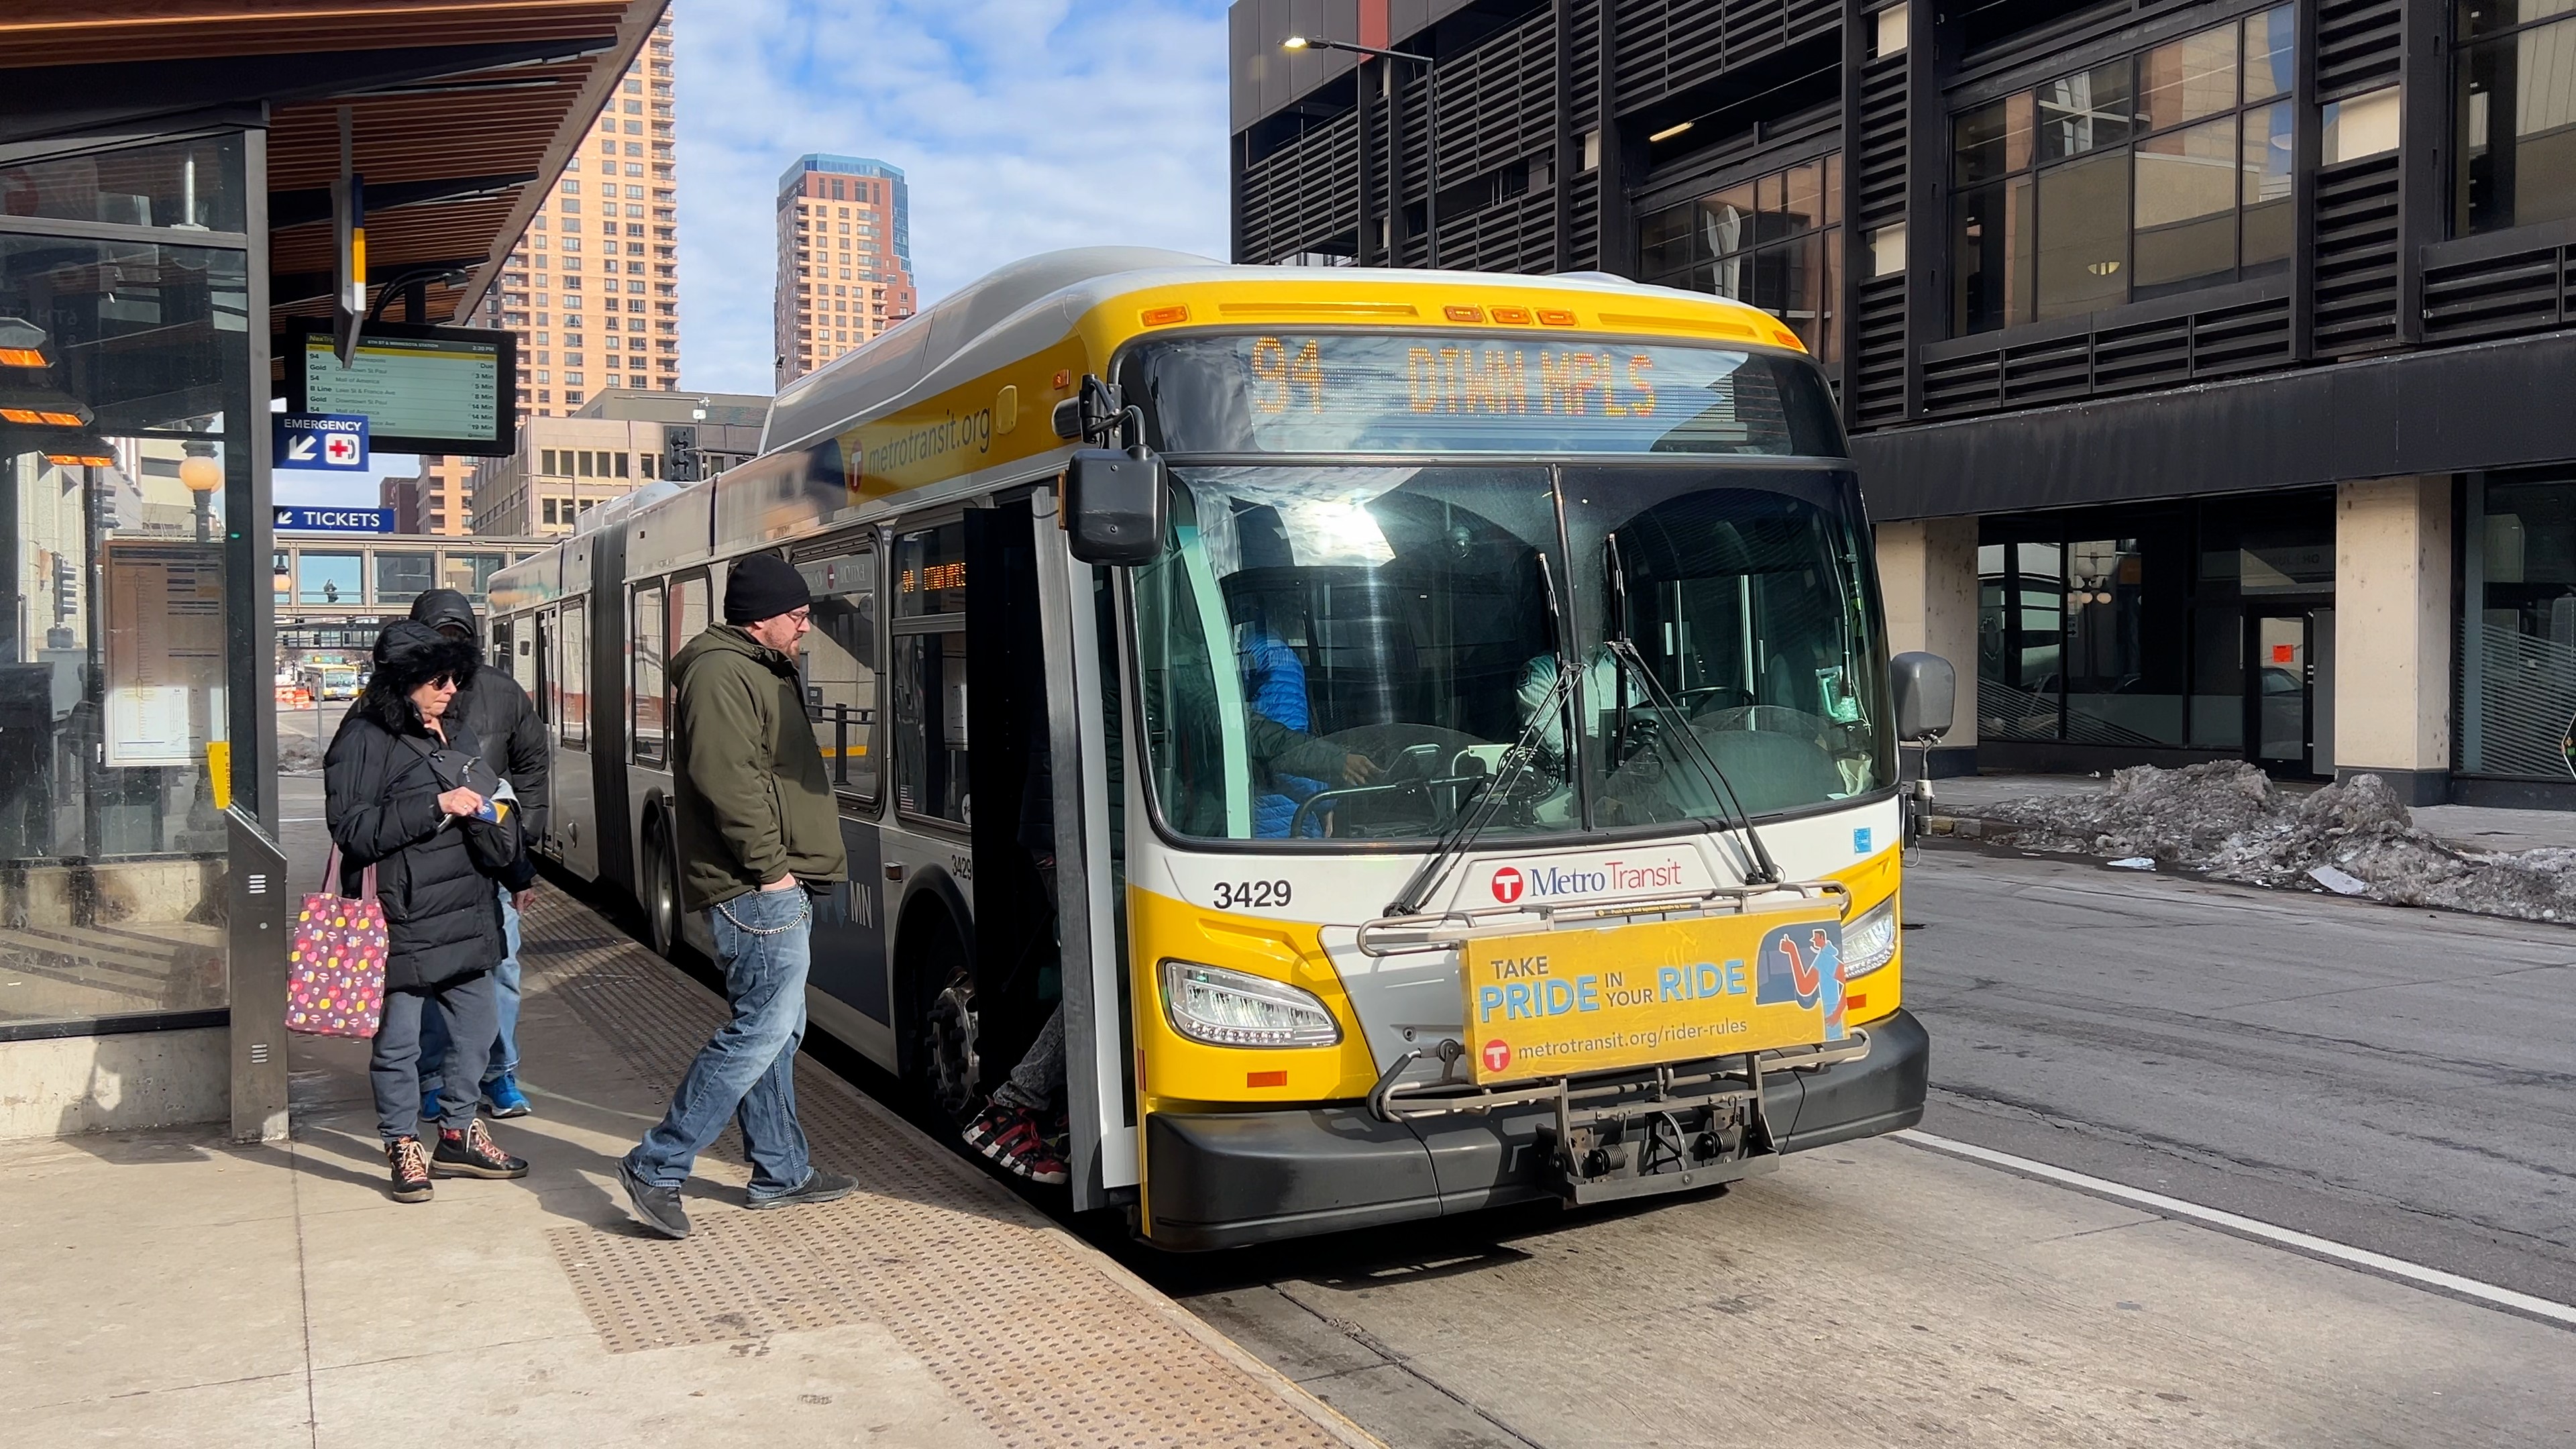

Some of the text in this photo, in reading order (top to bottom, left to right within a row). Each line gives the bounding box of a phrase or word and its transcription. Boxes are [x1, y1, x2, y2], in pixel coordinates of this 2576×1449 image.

[1252, 336, 1656, 417] 94 DTWN MPLS
[284, 418, 362, 431] EMERGENCY
[869, 408, 990, 475] metrotransit.org
[303, 511, 380, 527] TICKETS
[951, 854, 973, 881] 3429
[1529, 859, 1682, 897] Metro Transit
[850, 879, 873, 929] MN
[1213, 879, 1292, 910] 3429
[1491, 956, 1549, 979] TAKE
[1479, 959, 1748, 1023] PRIDE IN YOUR RIDE
[1518, 1017, 1748, 1060] metrotransit.org/rider-rules
